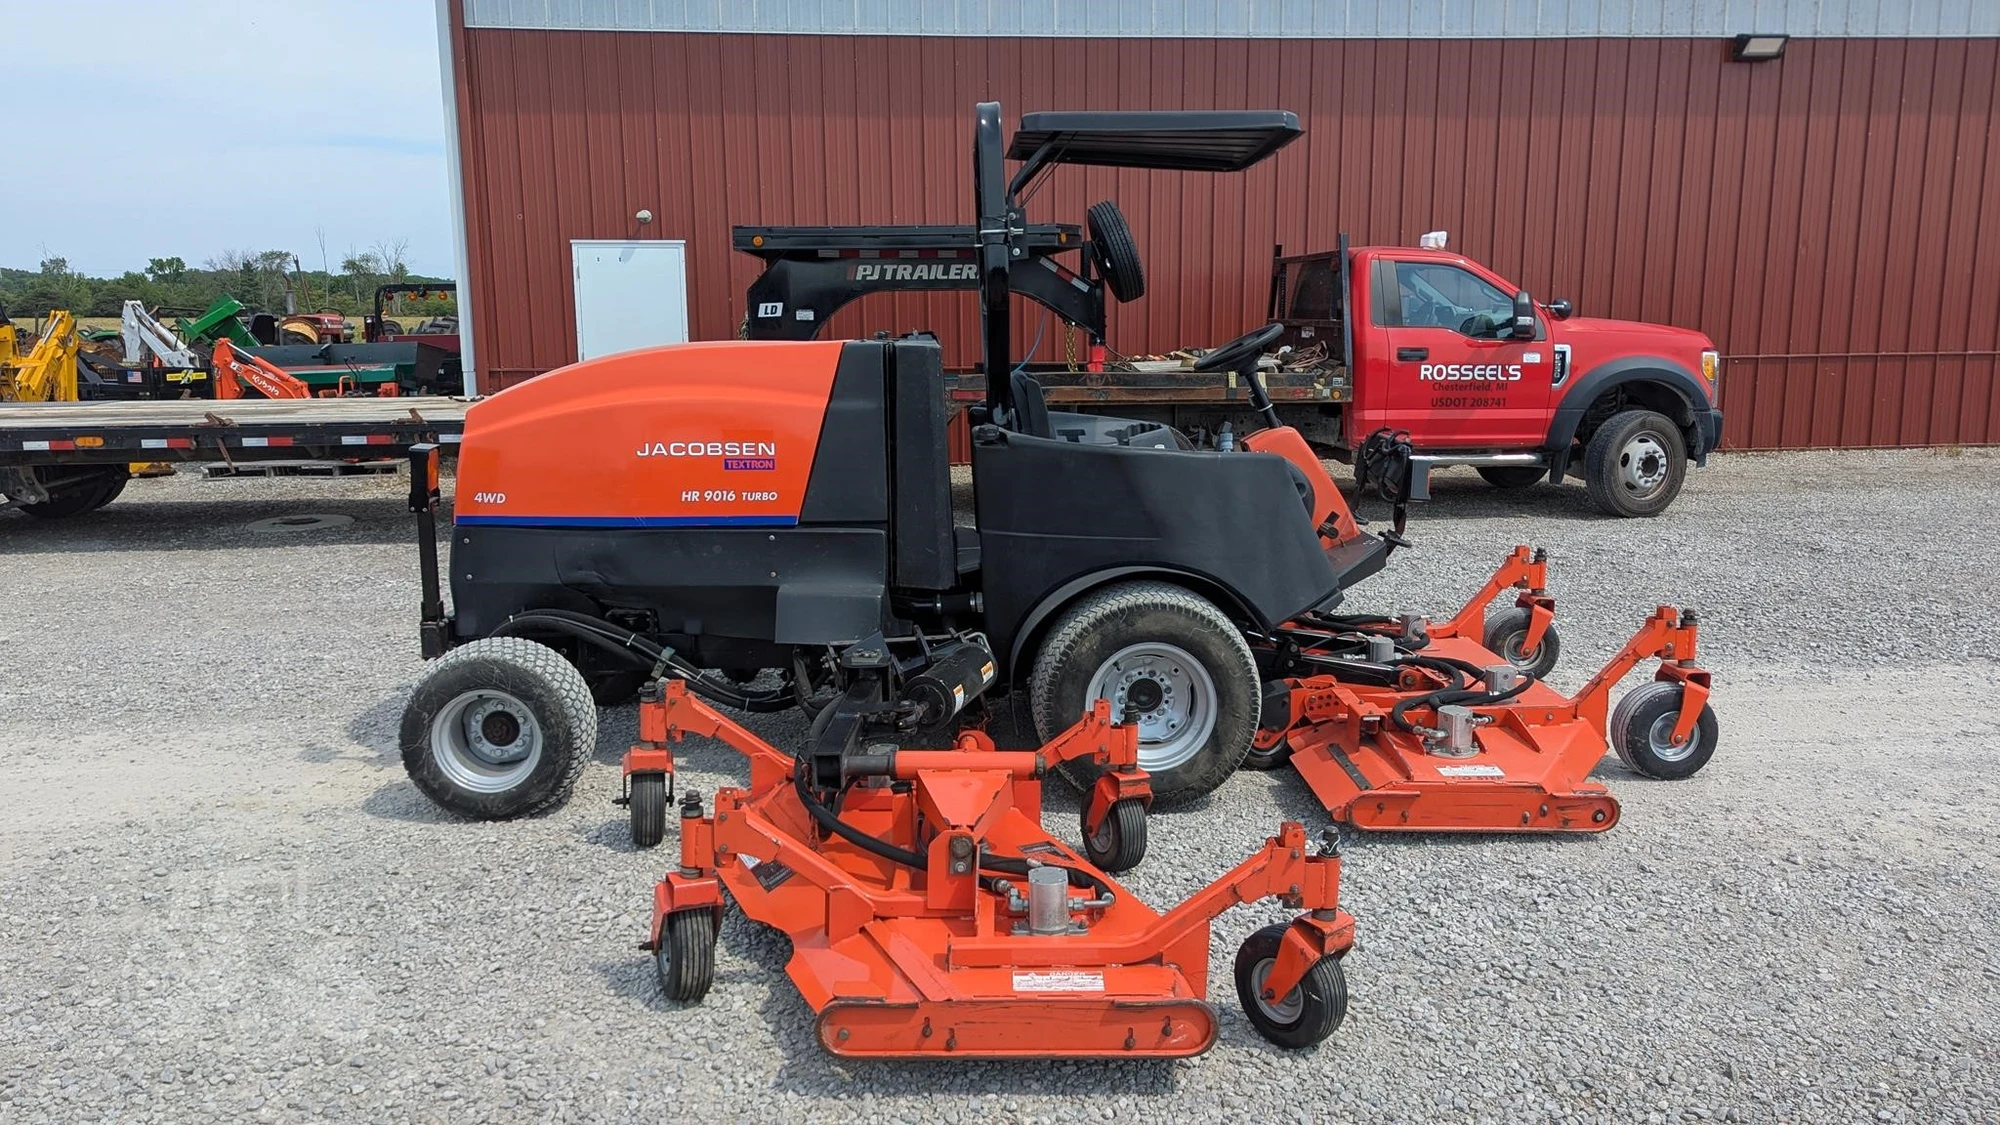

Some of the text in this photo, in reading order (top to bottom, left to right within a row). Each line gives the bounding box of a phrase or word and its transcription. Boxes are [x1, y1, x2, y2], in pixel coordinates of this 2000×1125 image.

[856, 264, 979, 280] PJ TRAILER
[764, 305, 778, 316] LD
[1420, 364, 1522, 381] ROSSEEL'S
[251, 374, 280, 396] Kubota
[1432, 382, 1508, 392] Chesterfield, MI
[1431, 397, 1507, 407] USDOT 208741
[636, 442, 775, 457] JACOBSEN
[726, 459, 774, 470] TEXTRON
[473, 492, 506, 504] 4WD
[681, 490, 778, 502] HR 9016 TURBO
